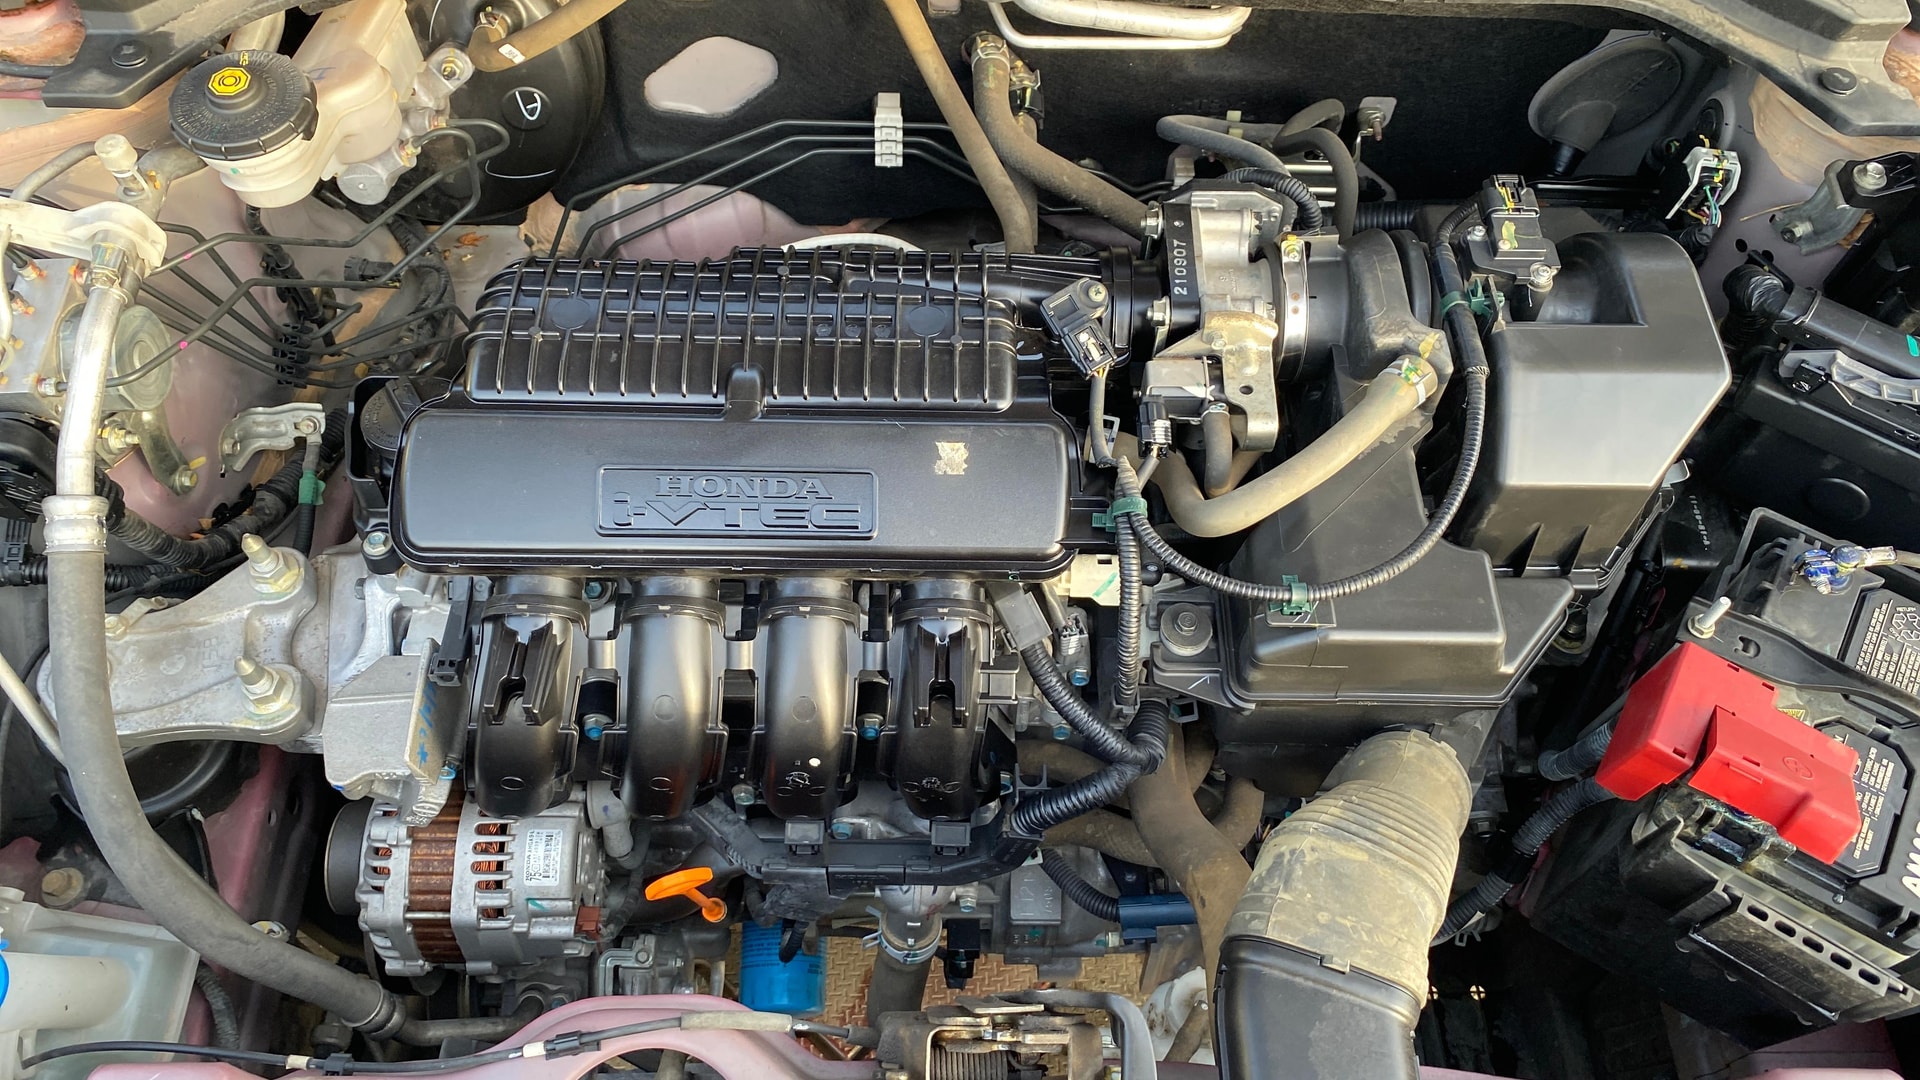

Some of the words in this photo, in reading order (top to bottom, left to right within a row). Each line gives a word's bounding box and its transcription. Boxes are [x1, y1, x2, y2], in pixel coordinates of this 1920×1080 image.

[1173, 239, 1188, 295] 210907
[655, 474, 834, 500] HONDA
[613, 491, 861, 530] i-VTEC
